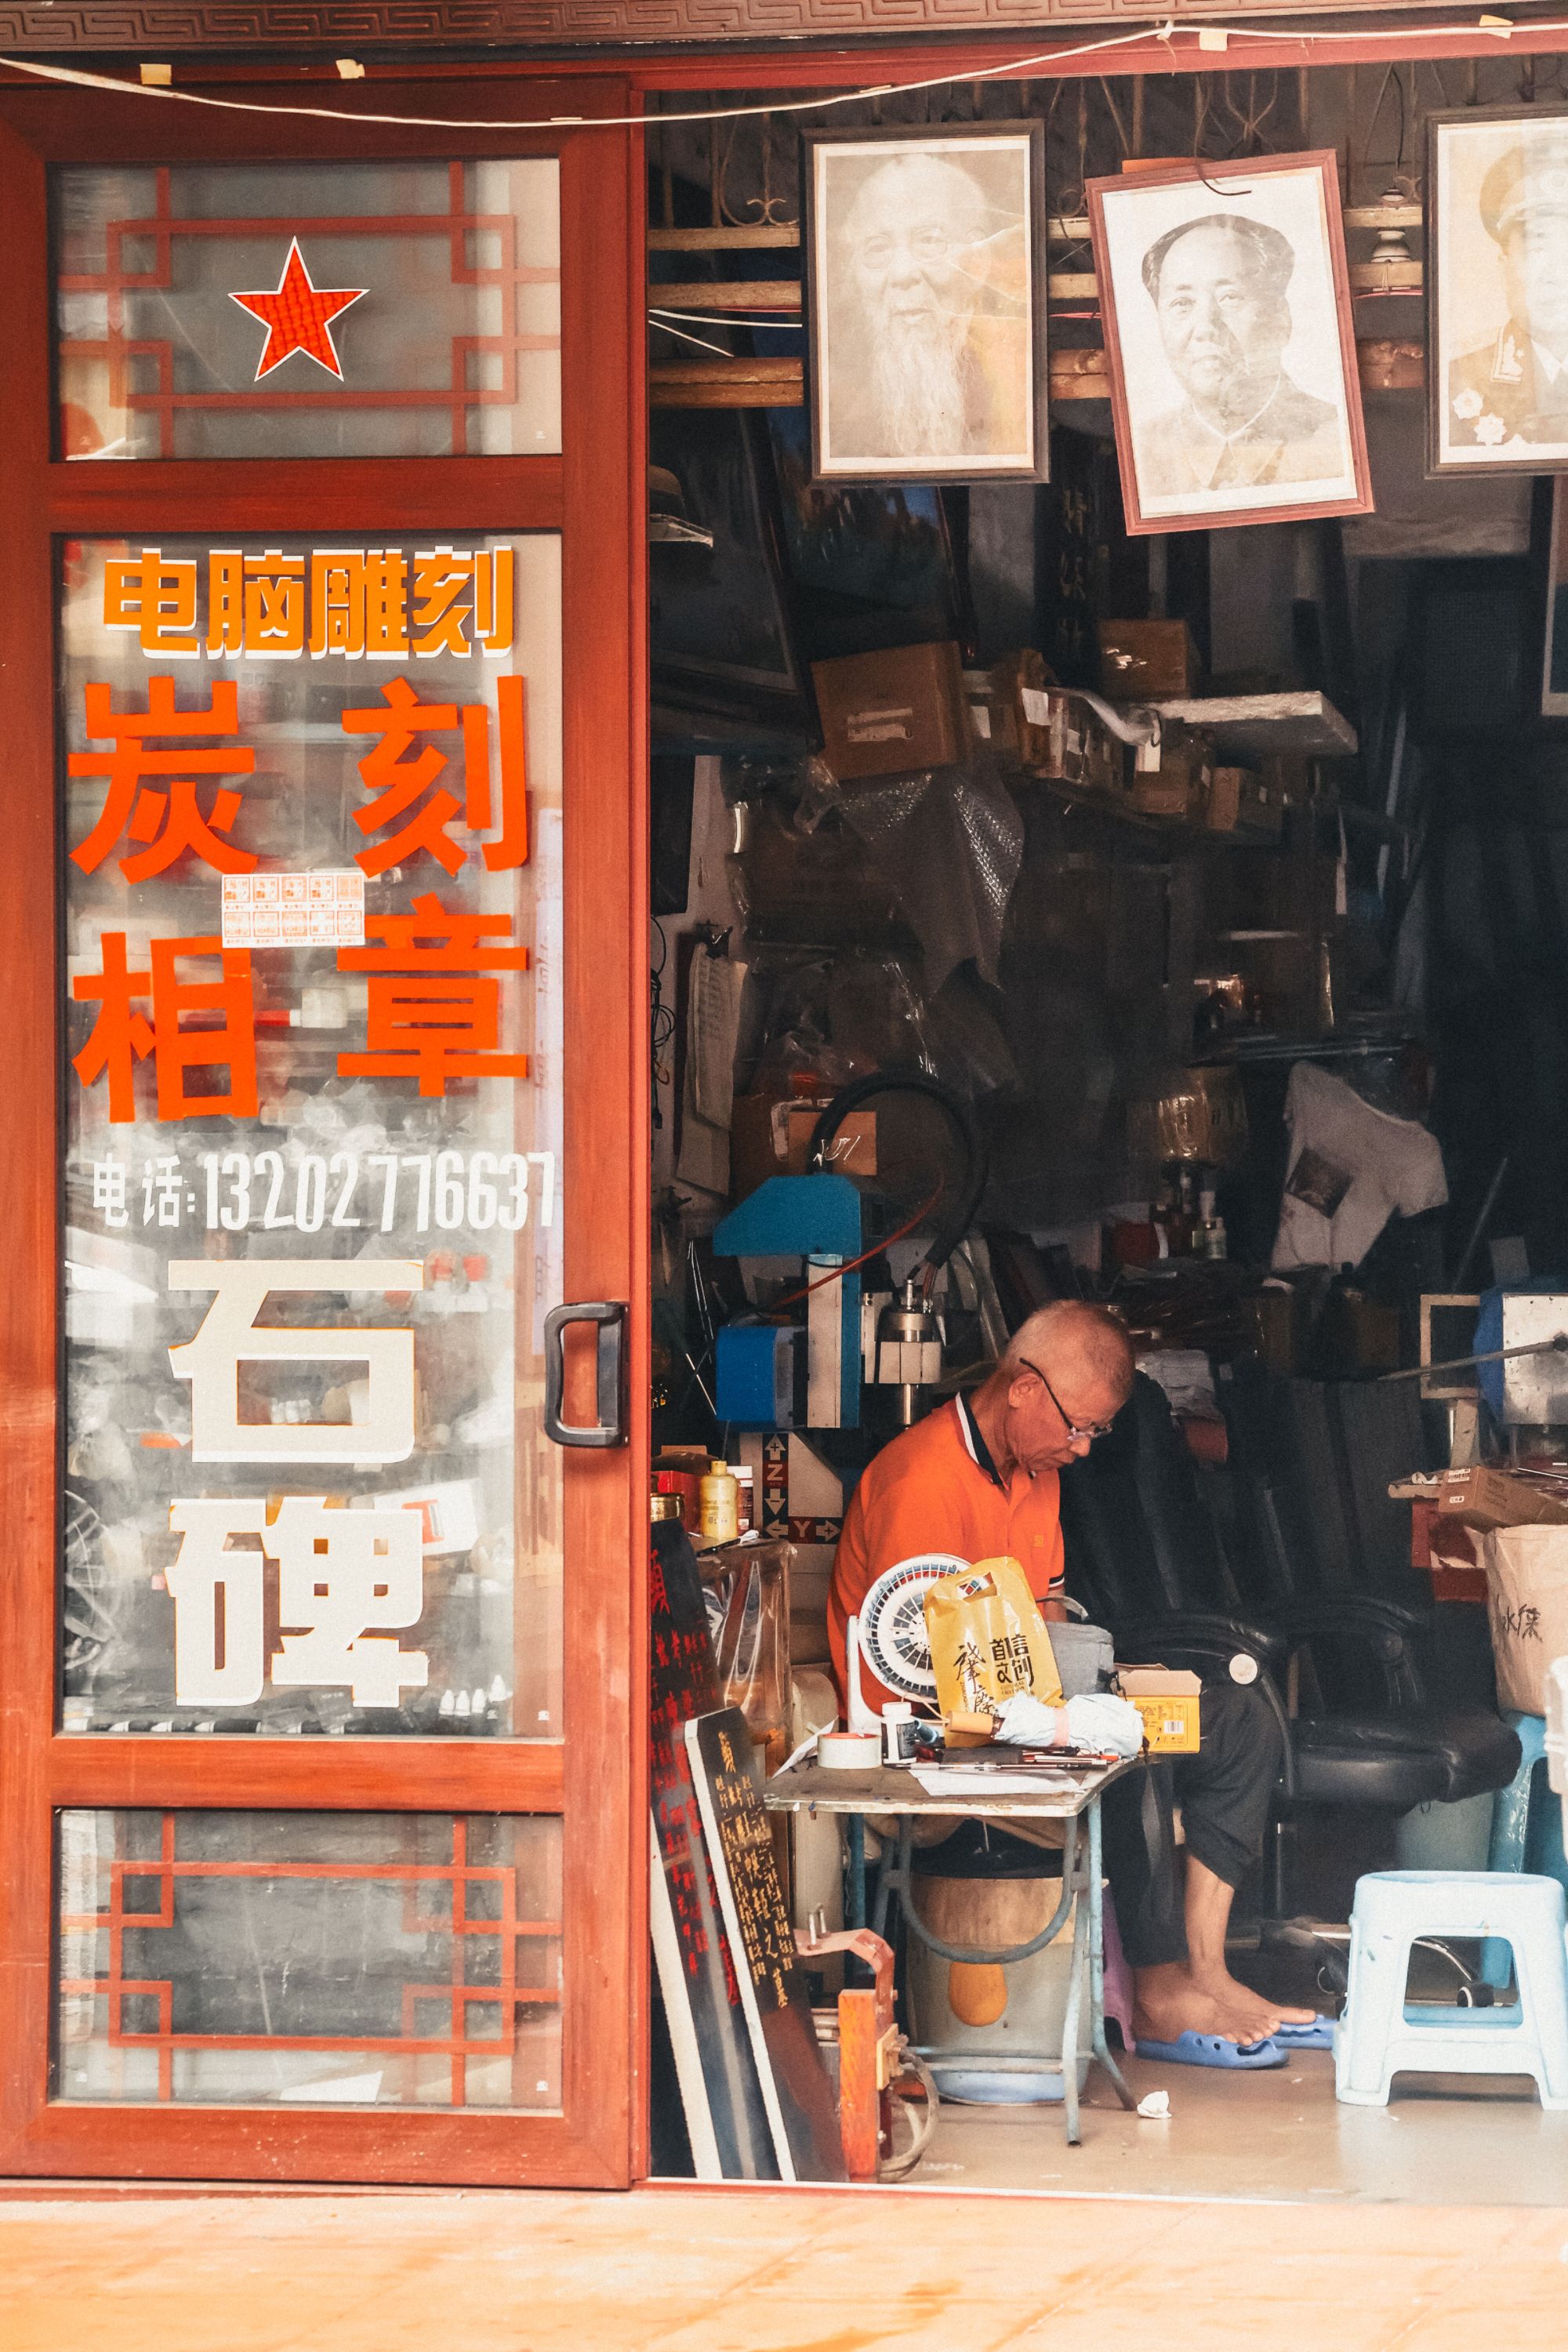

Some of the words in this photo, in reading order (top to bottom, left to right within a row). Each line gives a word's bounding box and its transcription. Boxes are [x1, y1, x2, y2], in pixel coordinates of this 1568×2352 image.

[103, 545, 514, 660] 电脑雕刻
[767, 1463, 784, 1481] Z
[793, 1520, 811, 1537] Y
